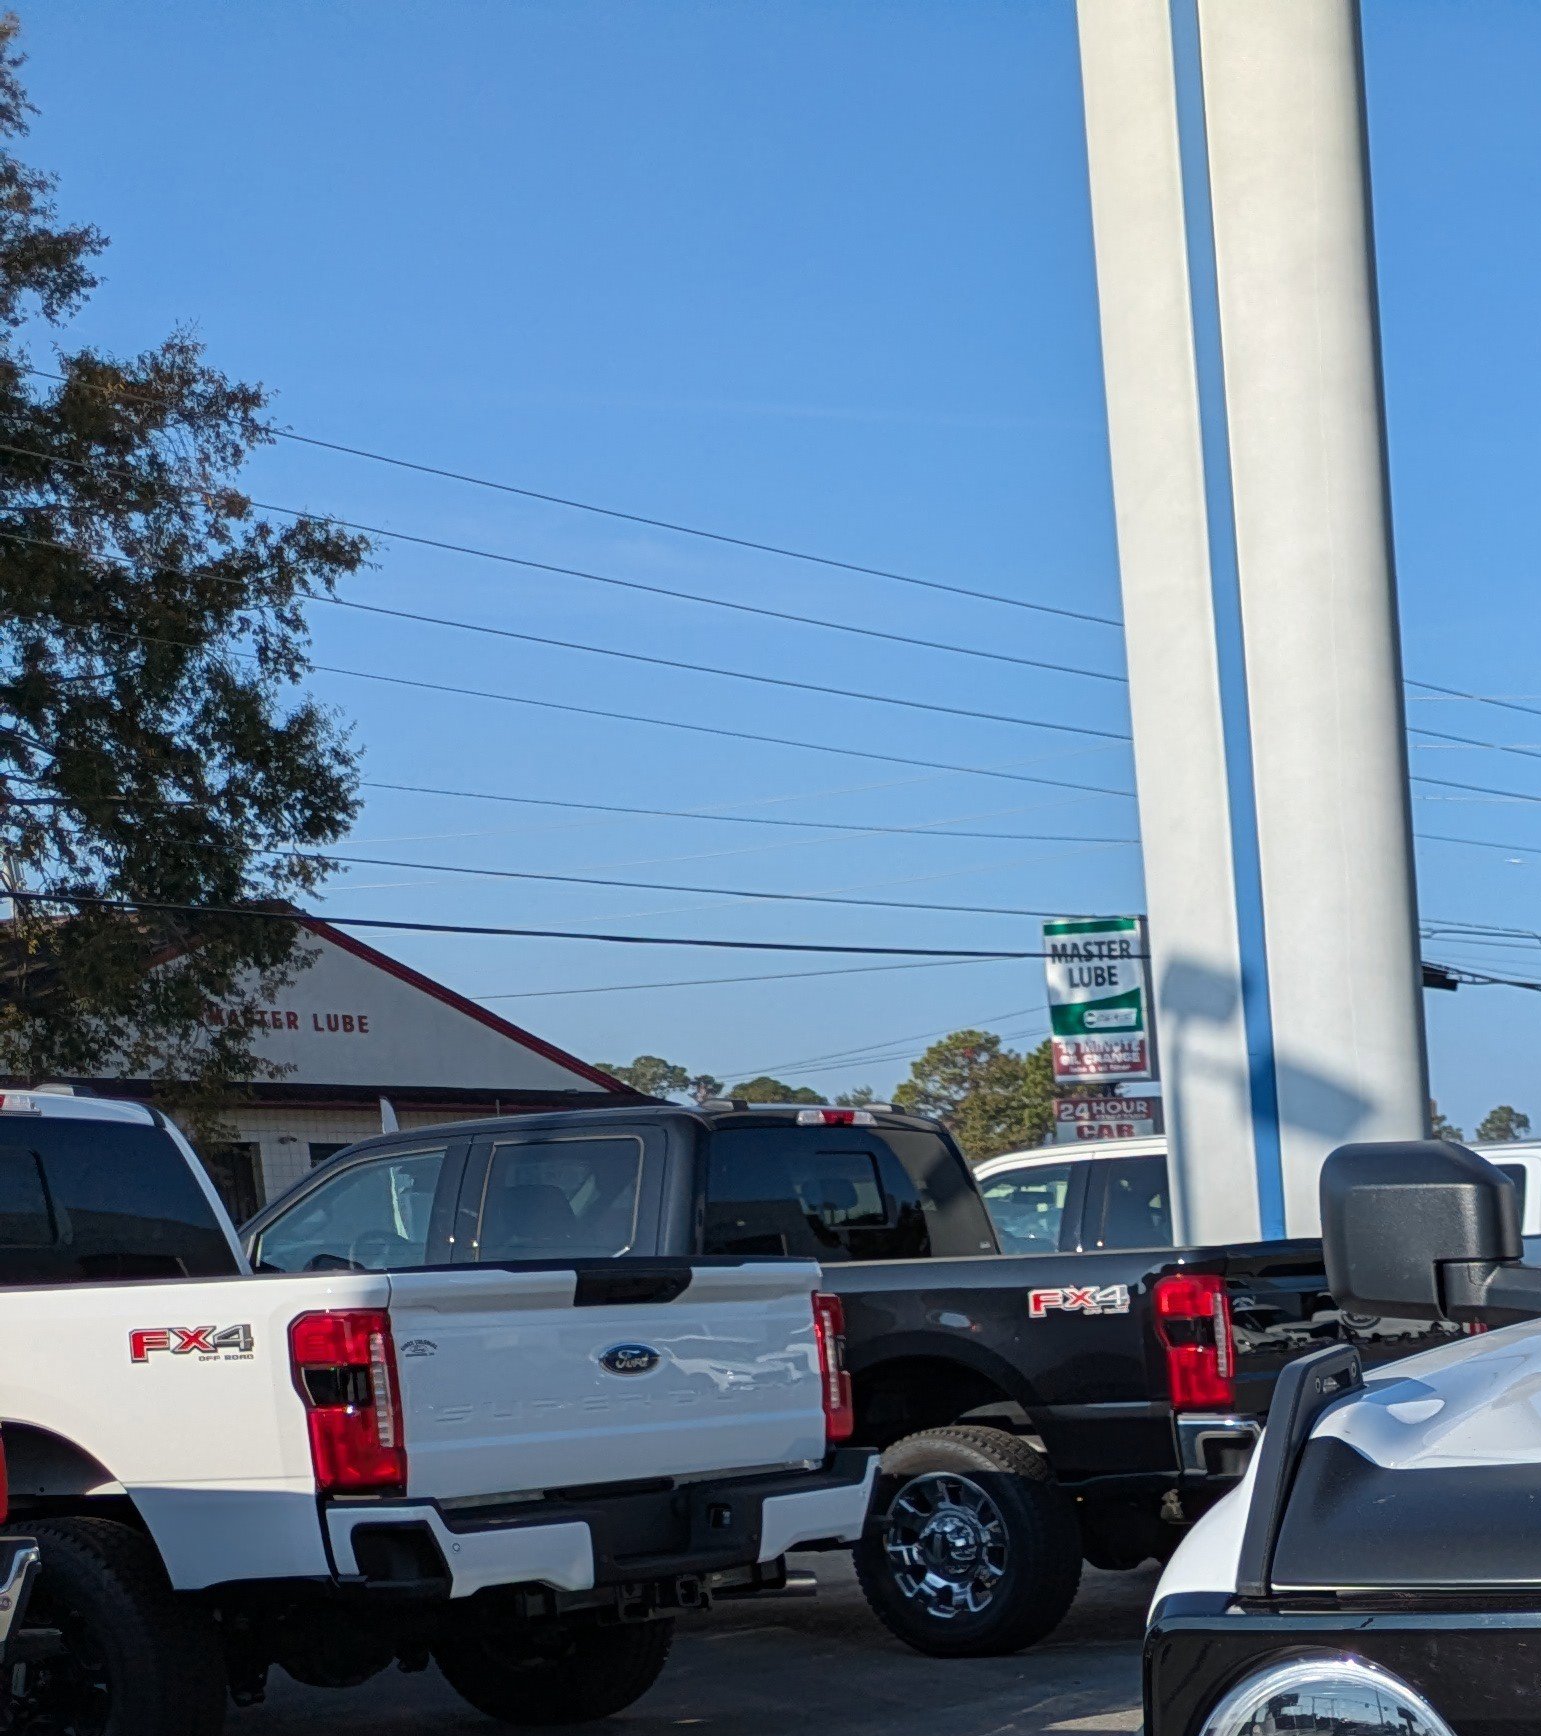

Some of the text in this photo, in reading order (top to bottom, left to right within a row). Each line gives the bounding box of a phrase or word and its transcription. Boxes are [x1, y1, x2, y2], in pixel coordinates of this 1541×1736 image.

[1051, 940, 1132, 964] MASTER
[1068, 966, 1119, 988] LUBE
[206, 1009, 370, 1034] MATER LUBE
[1060, 1101, 1148, 1120] 24 HOUR
[1076, 1123, 1135, 1140] CAR
[1028, 1284, 1130, 1318] FX4
[129, 1324, 254, 1363] FX4
[615, 1349, 650, 1369] Ford
